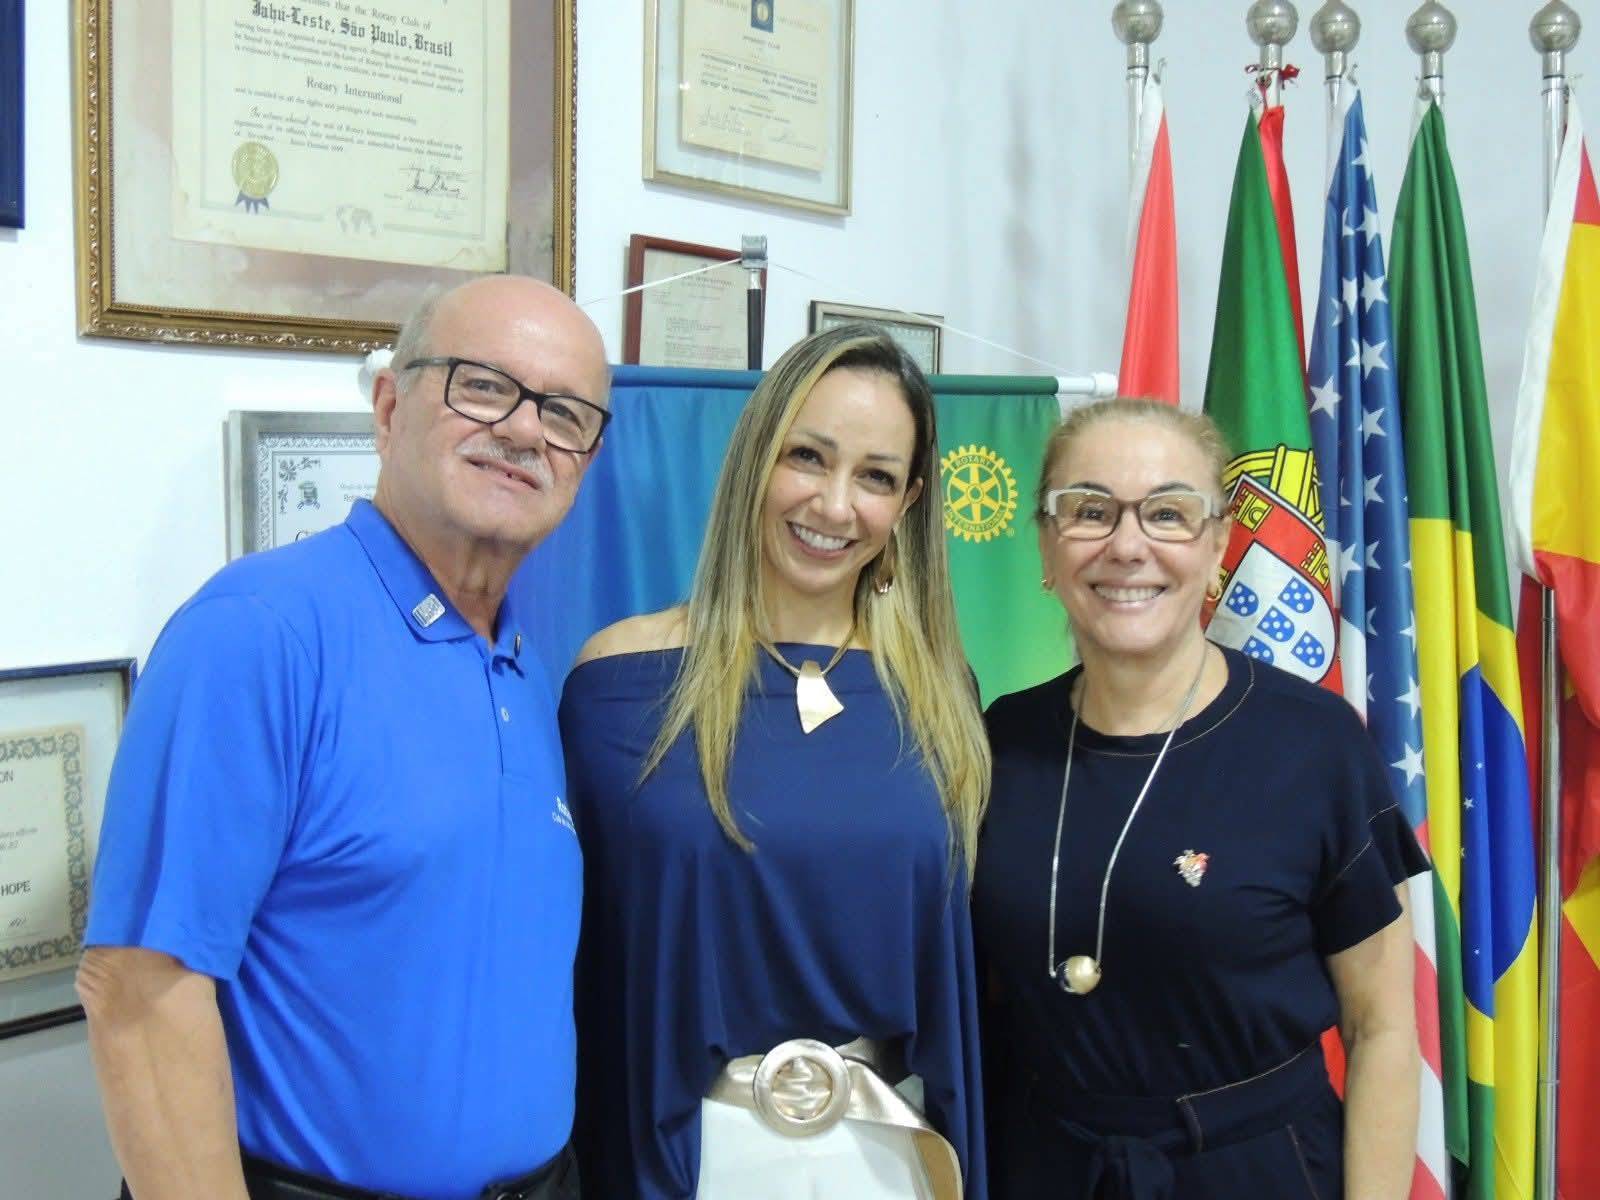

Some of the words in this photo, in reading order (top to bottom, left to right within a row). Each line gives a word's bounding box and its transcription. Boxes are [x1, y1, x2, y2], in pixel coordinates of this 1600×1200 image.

[335, 0, 350, 11] that
[354, 5, 367, 16] the
[371, 7, 397, 25] Rotary
[401, 15, 419, 28] Club
[423, 20, 432, 31] of
[414, 33, 453, 57] Brasil
[306, 76, 338, 96] Rotary
[344, 83, 402, 105] International
[954, 454, 992, 469] ROTARY
[1, 880, 32, 898] HOPE
